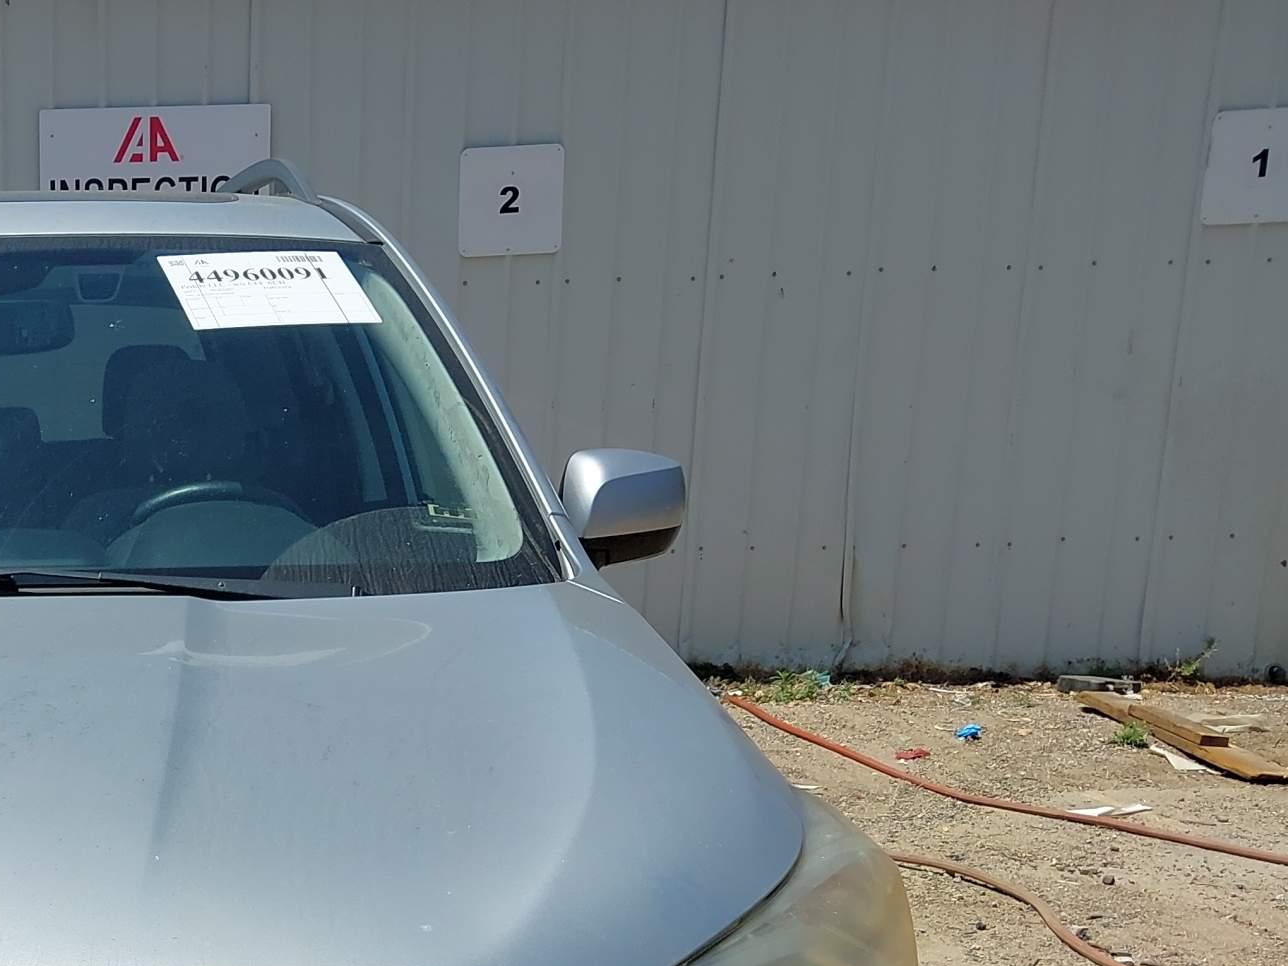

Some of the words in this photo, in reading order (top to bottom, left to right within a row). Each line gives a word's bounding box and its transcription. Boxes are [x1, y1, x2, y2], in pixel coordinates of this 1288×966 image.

[1251, 148, 1270, 178] 1
[499, 186, 521, 215] 2
[188, 267, 329, 284] 44960091
